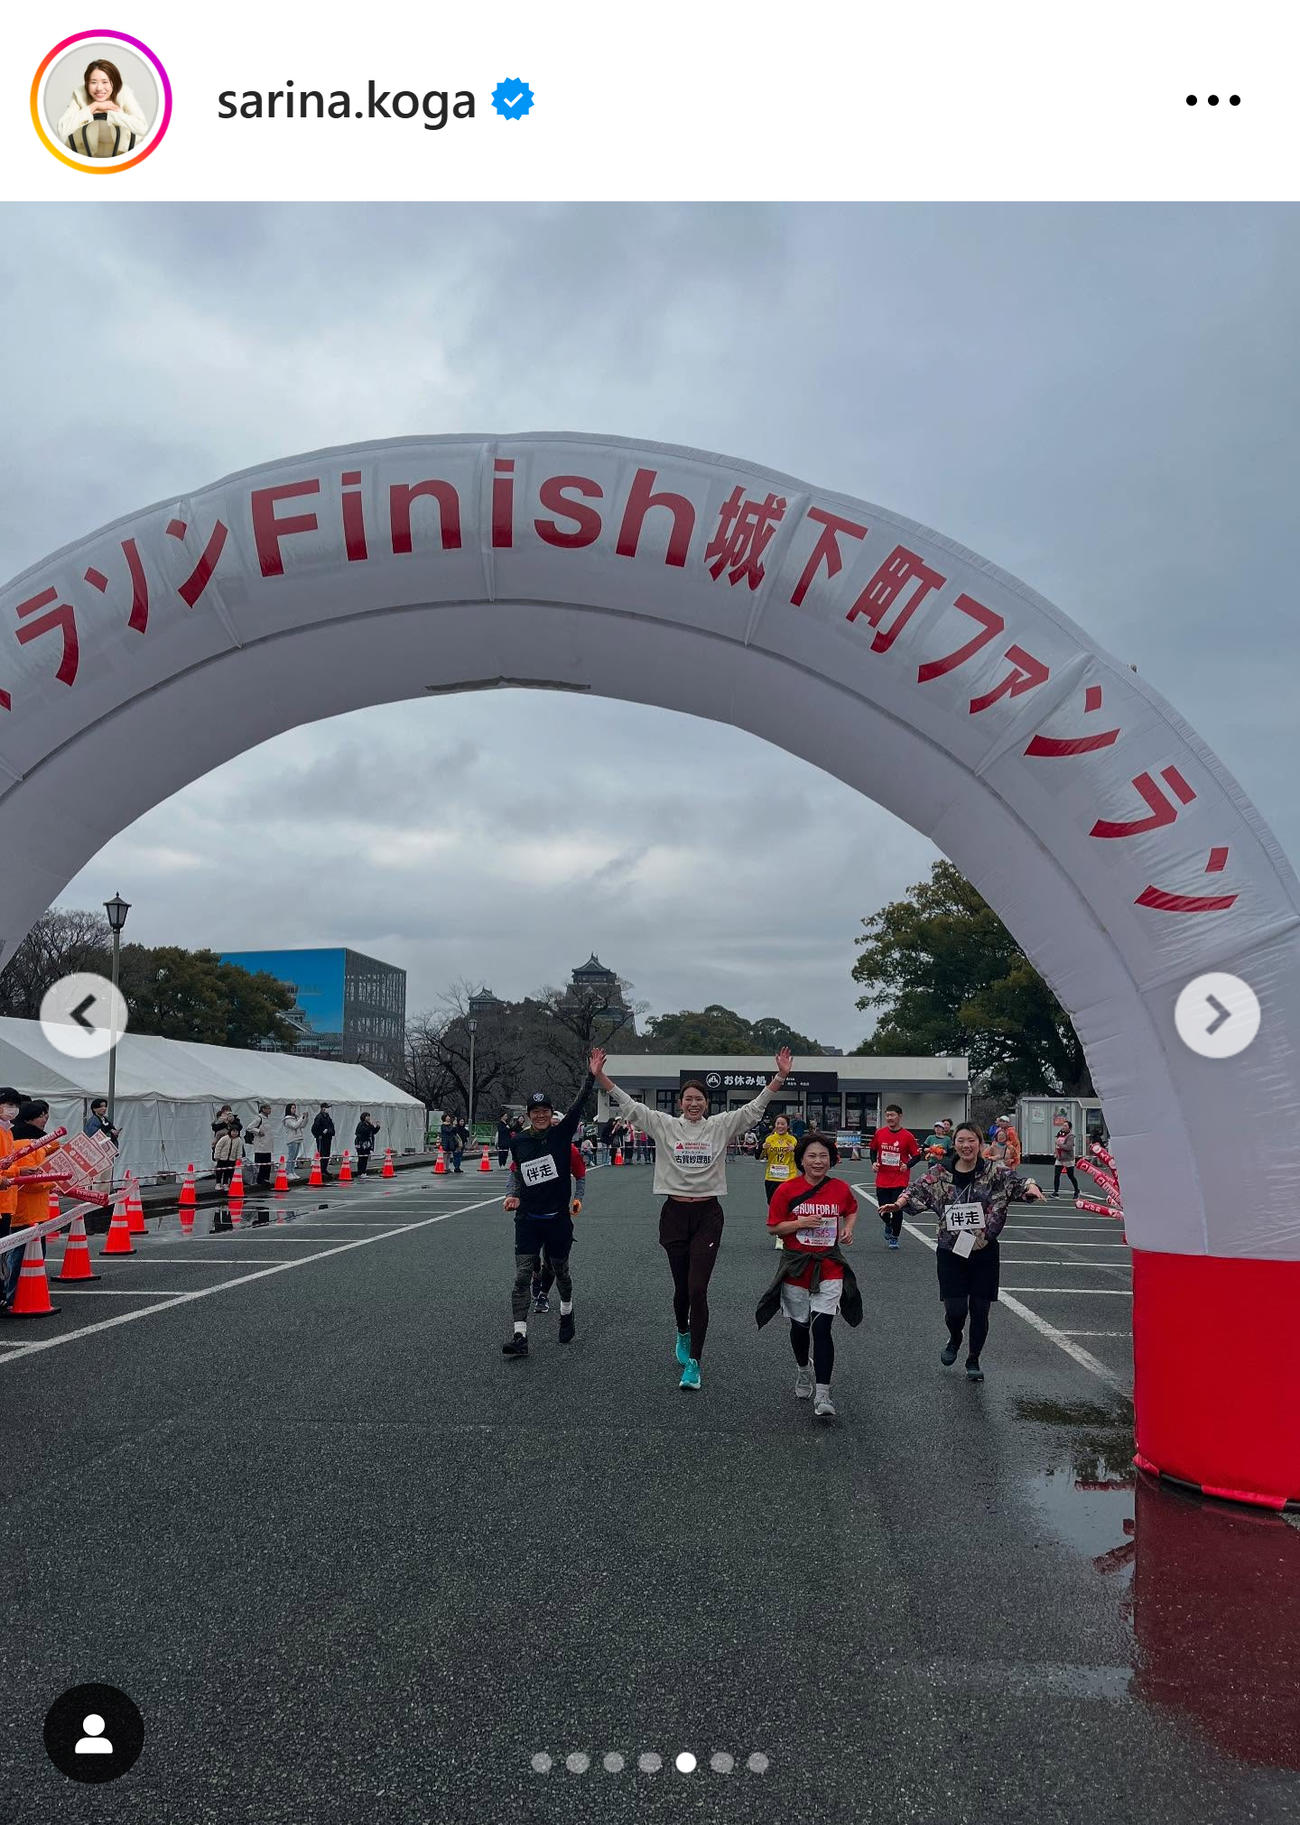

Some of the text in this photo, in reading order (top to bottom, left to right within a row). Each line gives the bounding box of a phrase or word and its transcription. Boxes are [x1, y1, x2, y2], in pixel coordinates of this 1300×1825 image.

[0, 460, 1238, 913] ラソン Finish 城下町ファンラン
[723, 1075, 767, 1087] お休み処
[526, 1163, 554, 1182] 伴走
[799, 1202, 815, 1215] RUN
[816, 1203, 831, 1216] FOR
[950, 1210, 981, 1226] 伴走
